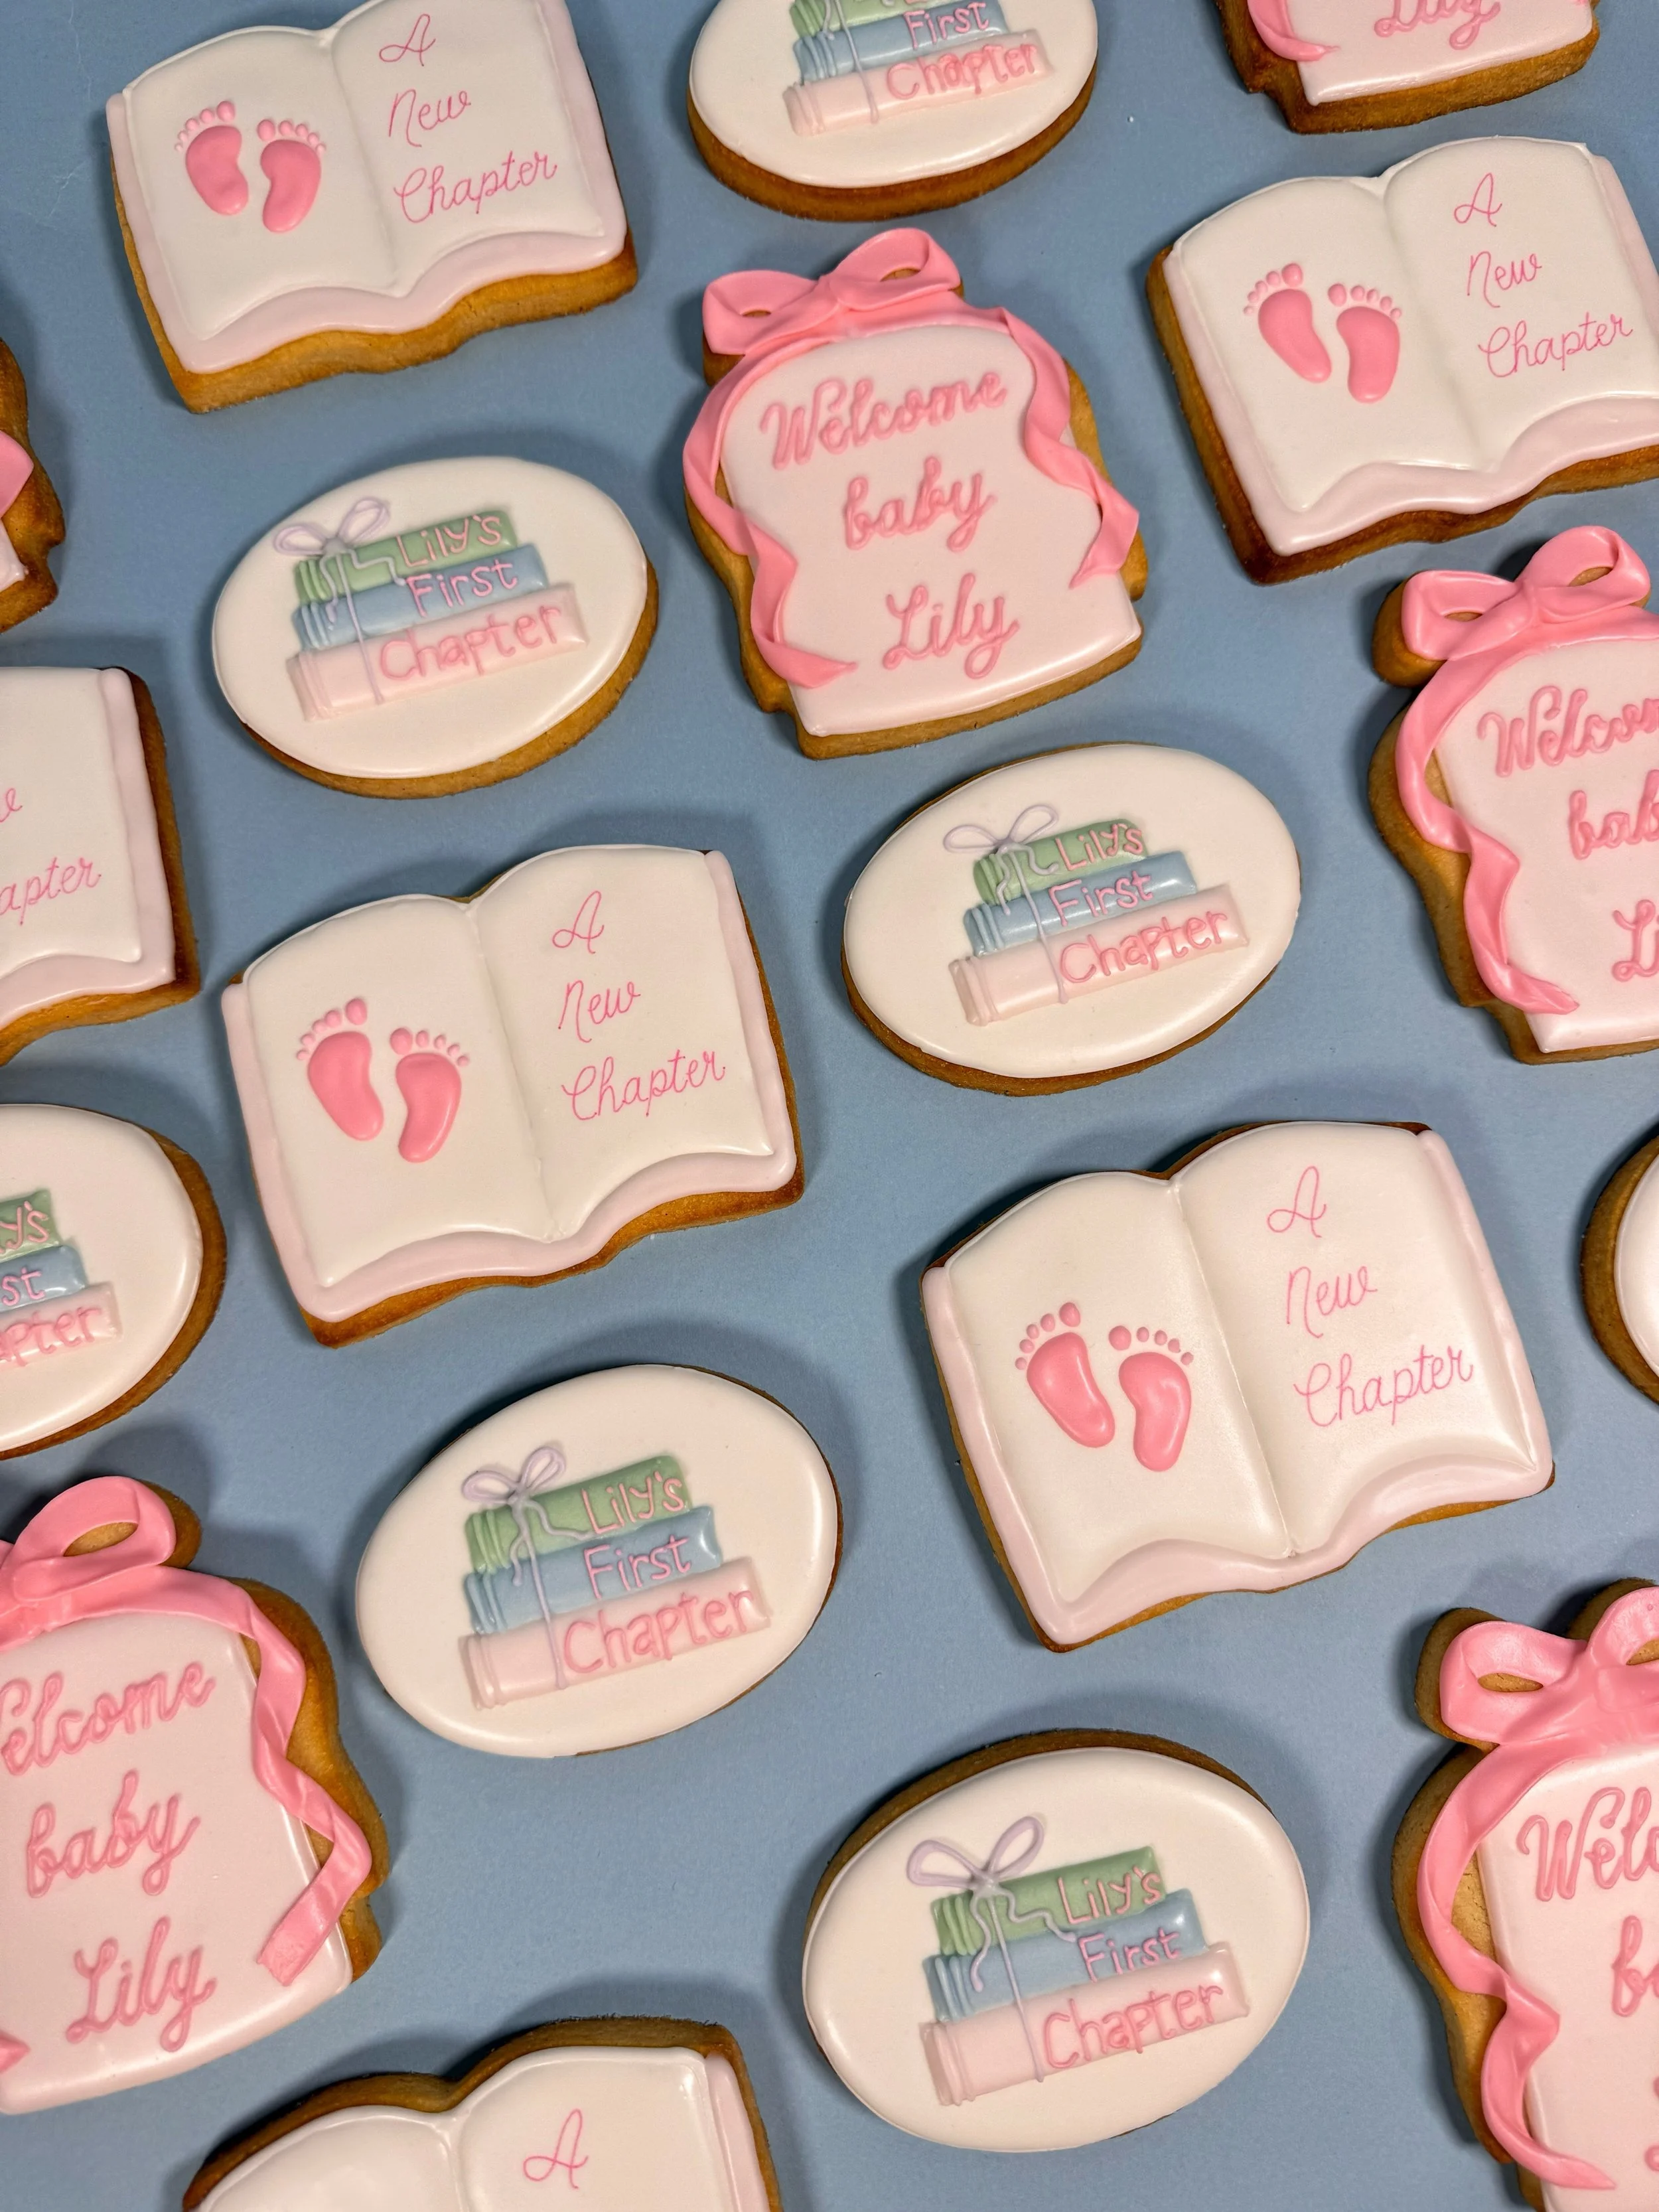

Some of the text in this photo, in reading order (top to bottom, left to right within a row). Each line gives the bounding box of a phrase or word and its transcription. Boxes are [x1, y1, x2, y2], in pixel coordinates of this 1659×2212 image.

[379, 13, 436, 66] A
[904, 1, 989, 50] First
[887, 43, 1037, 100] Chapter
[389, 89, 471, 147] New
[394, 150, 557, 223] Chapter
[1454, 173, 1502, 227] A
[1466, 251, 1542, 308] New
[1478, 312, 1634, 378] Chapter
[760, 372, 1007, 471] Welcome
[843, 455, 997, 552] baby
[396, 514, 502, 567] Lily's
[405, 559, 518, 618] First
[380, 605, 562, 682] Chapter
[881, 572, 1020, 679] Lily
[0, 857, 102, 926] apter
[552, 890, 605, 954] A
[1048, 871, 1153, 926] First
[1060, 911, 1228, 983] Chapter
[557, 980, 640, 1043] New
[561, 1049, 726, 1120] Chapter
[1267, 1165, 1327, 1238] A
[1286, 1266, 1378, 1338] New
[1293, 1345, 1473, 1427] Chapter
[581, 1471, 684, 1534] Lily's
[583, 1534, 691, 1599] First
[563, 1589, 753, 1674] Chapter
[0, 1662, 216, 1775] elcome
[27, 1770, 200, 1897] baby
[1058, 1866, 1163, 1924] Lily's
[66, 1915, 217, 2052] Lily
[1076, 1927, 1181, 1982] First
[1043, 1983, 1223, 2069] Chapter
[523, 2108, 589, 2189] A
